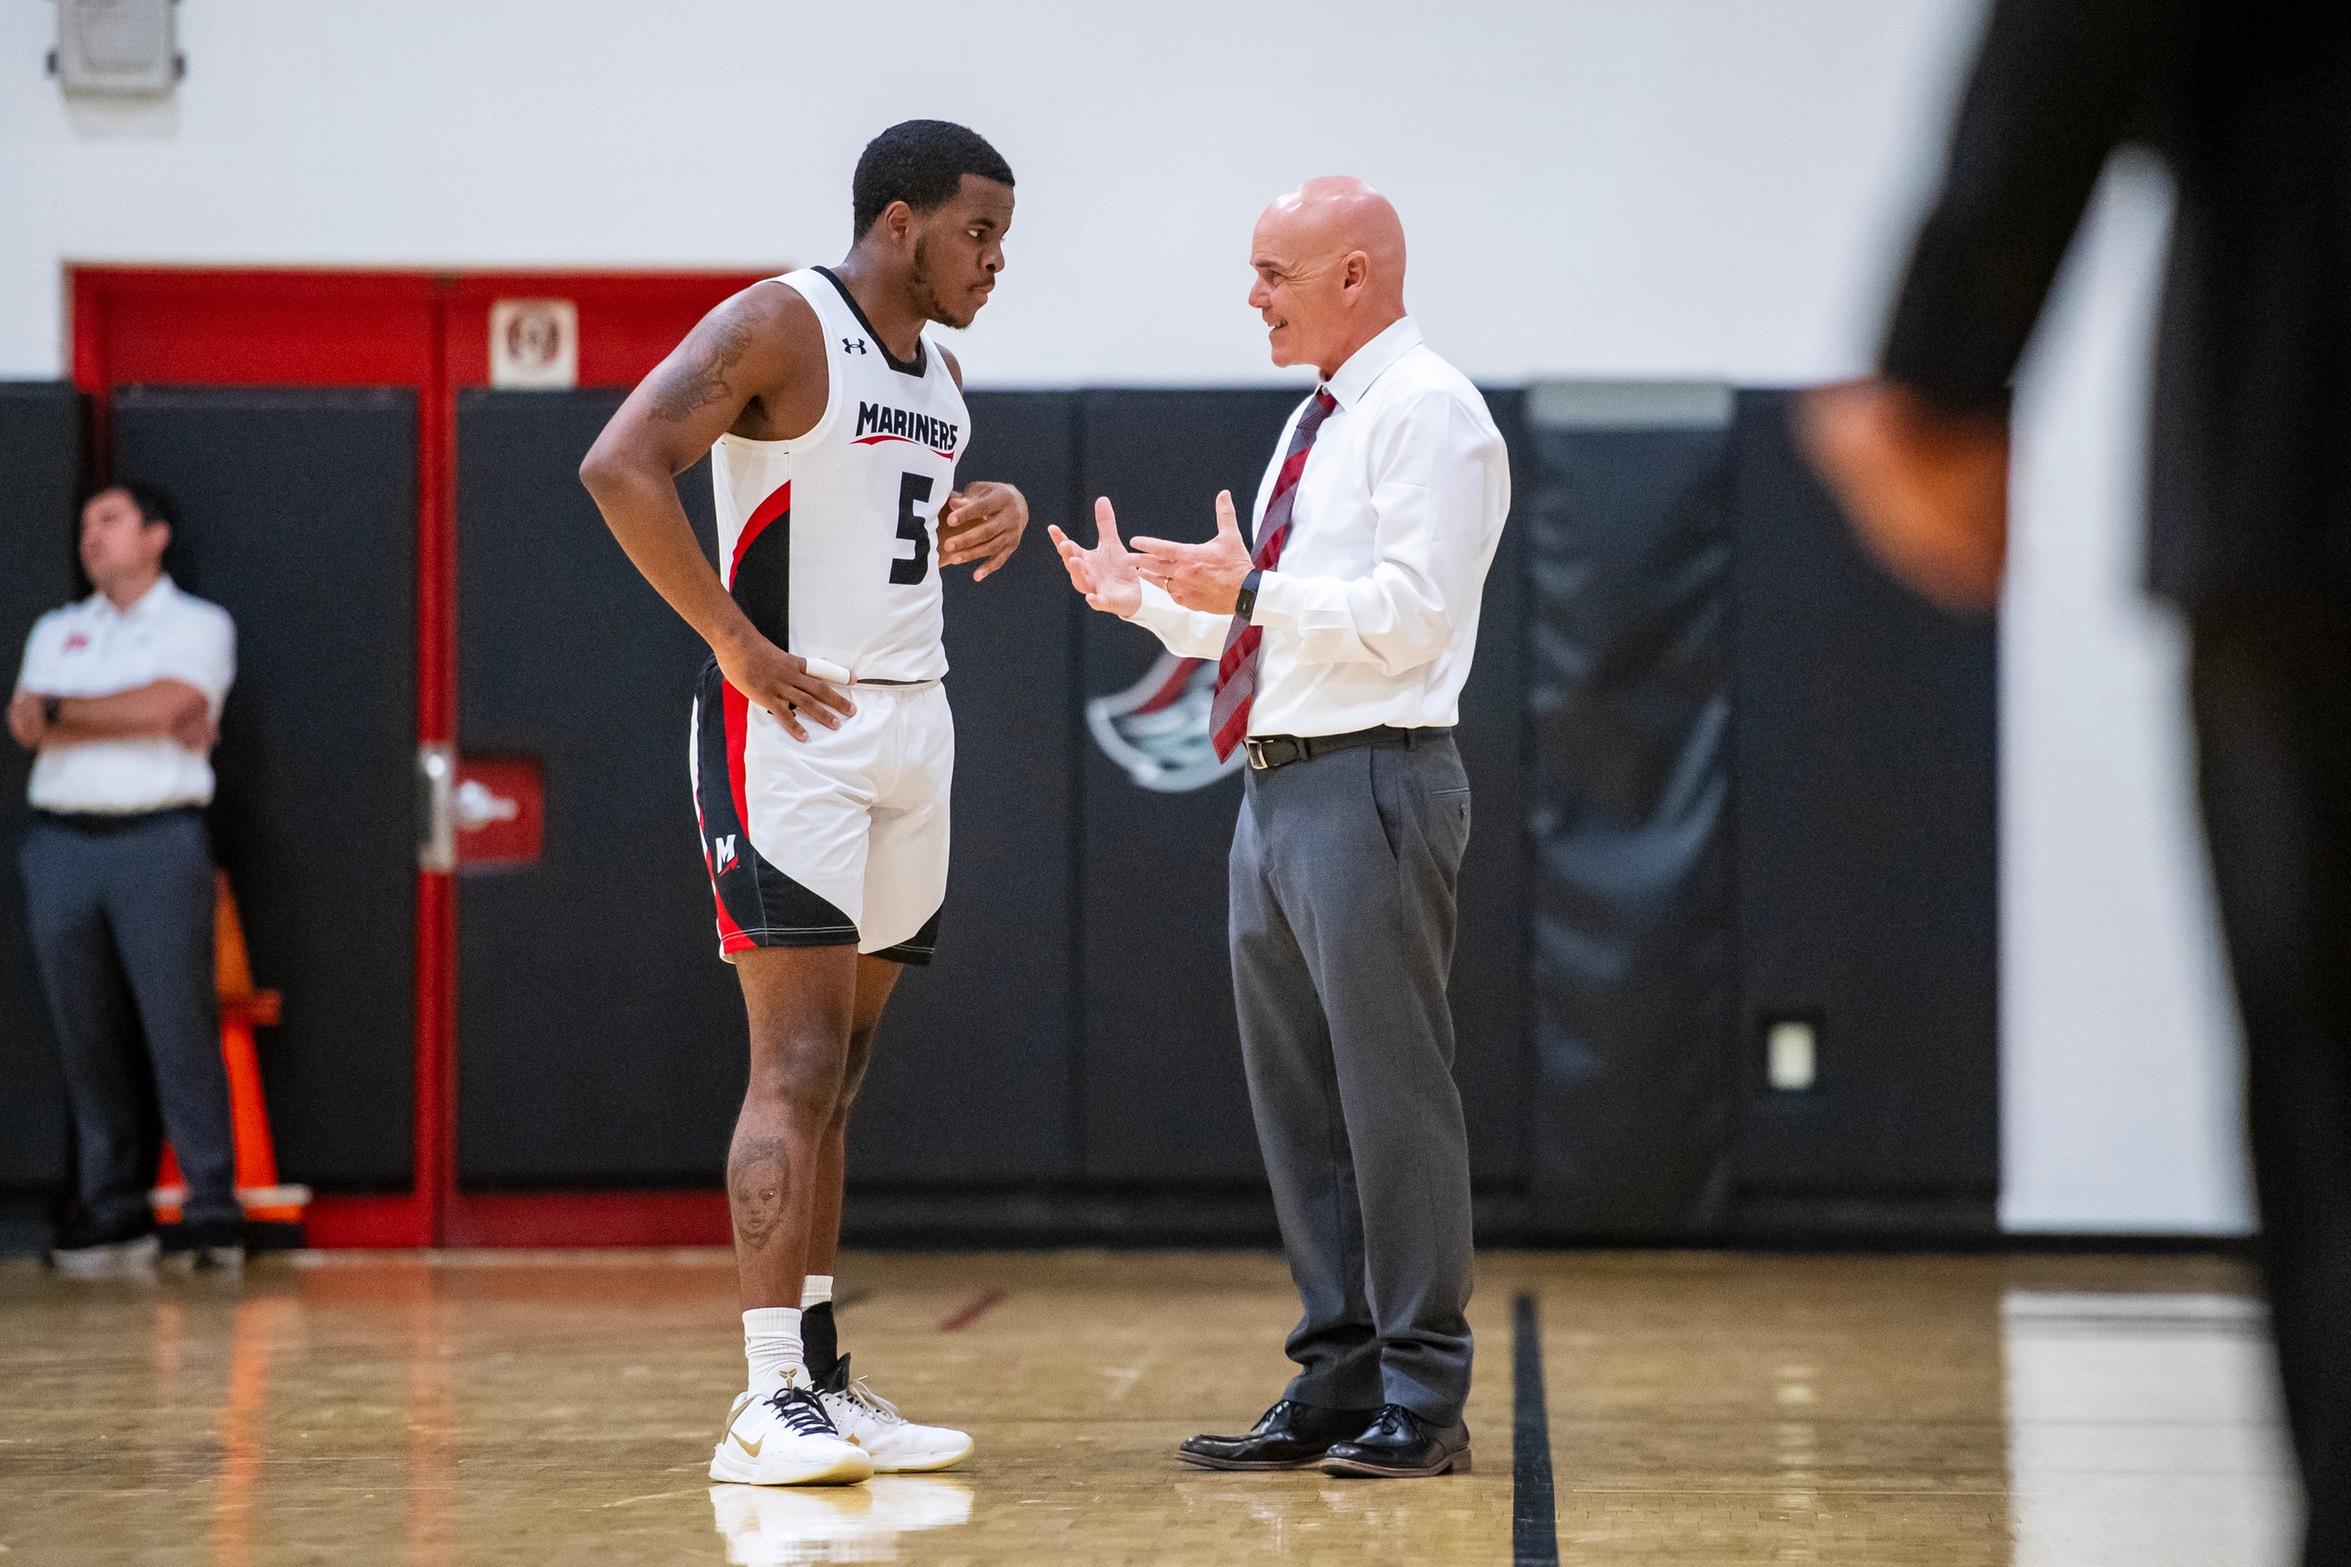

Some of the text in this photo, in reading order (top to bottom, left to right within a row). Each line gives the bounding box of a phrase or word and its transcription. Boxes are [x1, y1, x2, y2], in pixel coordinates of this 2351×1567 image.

[855, 401, 958, 451] MARINERS
[889, 471, 934, 585] 5
[715, 834, 736, 874] M
